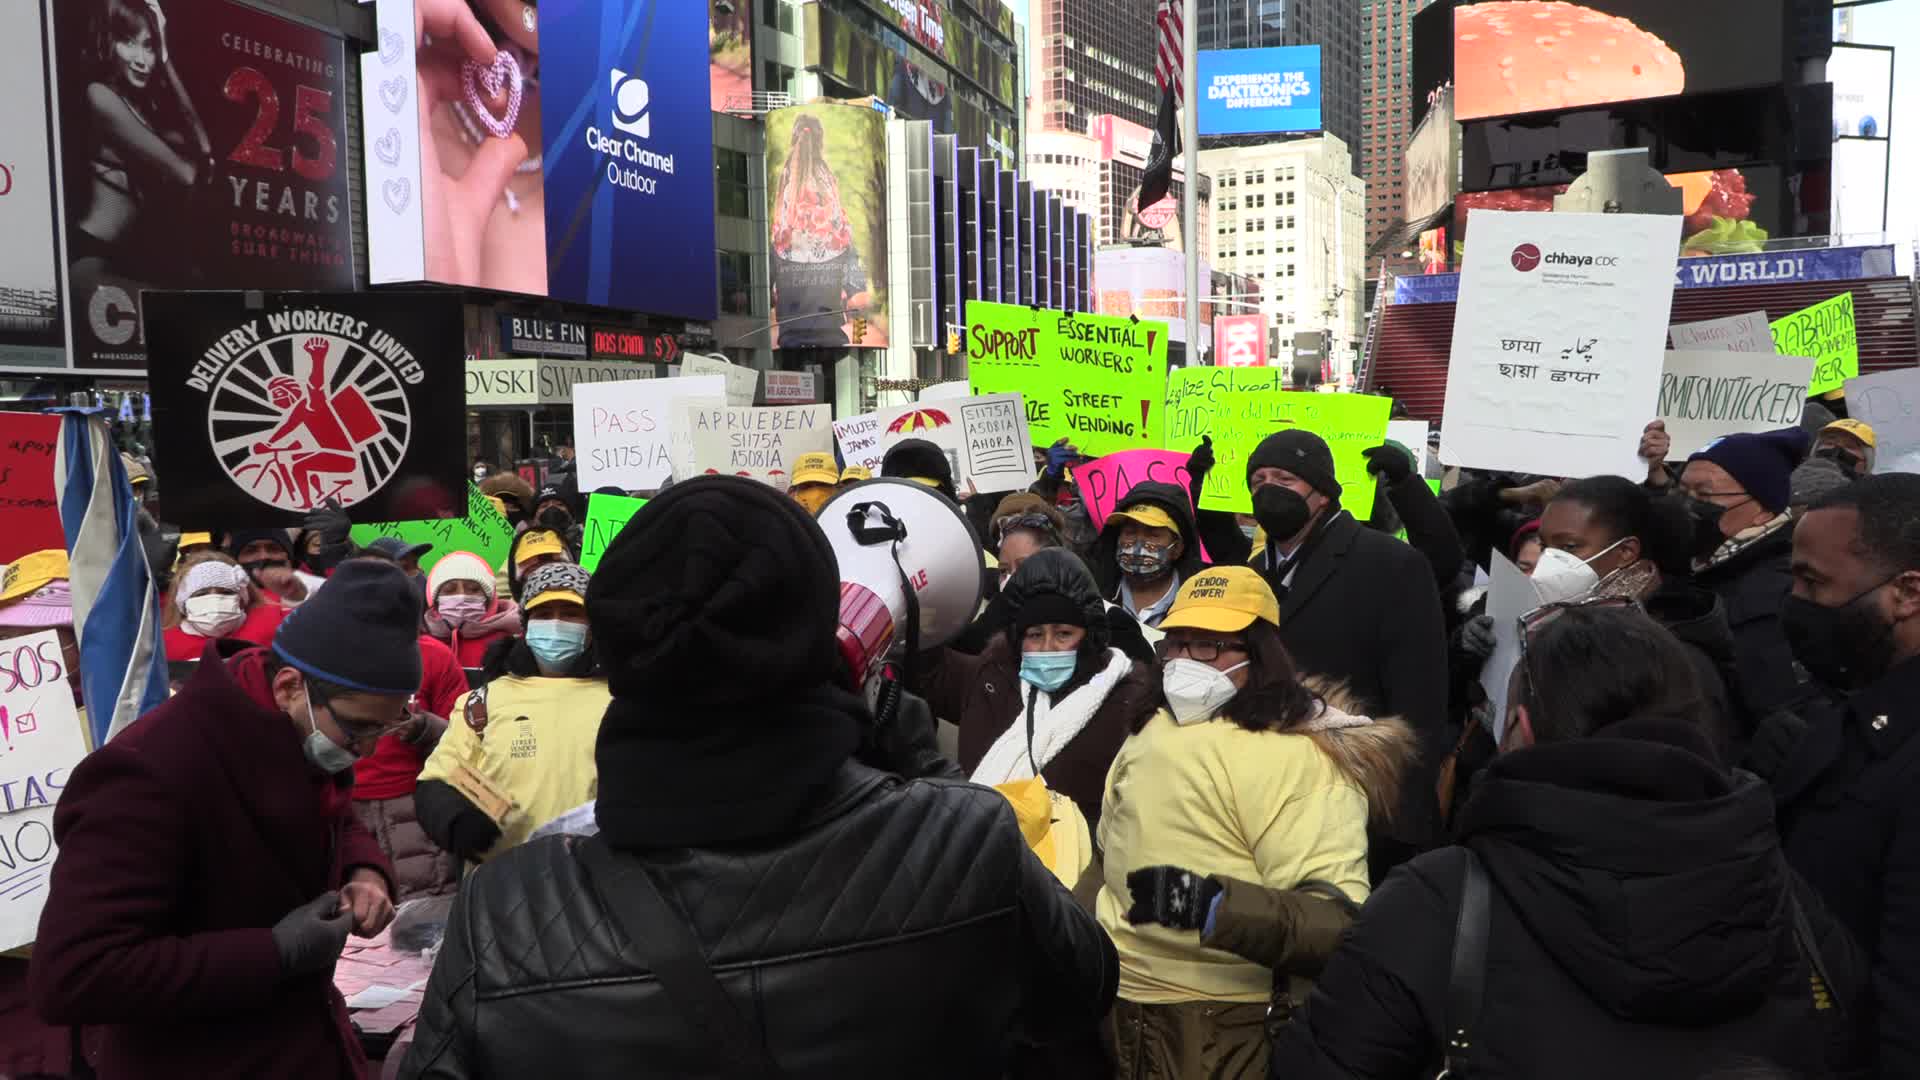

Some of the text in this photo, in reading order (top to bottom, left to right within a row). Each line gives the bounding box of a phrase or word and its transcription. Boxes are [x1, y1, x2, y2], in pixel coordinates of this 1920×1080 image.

[919, 4, 944, 44] Time
[222, 32, 336, 78] CELEBRATING
[1208, 81, 1311, 99] DAKTRONICS
[1213, 71, 1305, 86] EXPERIENCE THE
[1226, 96, 1292, 109] DIFFERENCE
[224, 66, 337, 180] 25
[586, 126, 674, 174] Clear Channel
[607, 161, 657, 195] Outdoor
[229, 175, 340, 224] YEARS
[1544, 251, 1620, 268] chhaya CDC
[1690, 258, 1804, 284] WORLD!
[512, 317, 586, 343] BLUE FIN
[970, 323, 1041, 361] SUPPORT
[1057, 317, 1145, 348] ESSENTIAL
[186, 309, 425, 393] DELIVERY WORKERS UNITED
[1059, 346, 1134, 374] WORKERS
[1063, 388, 1123, 410] STREET
[592, 407, 656, 437] PASS
[697, 409, 816, 430] APRUEBEN
[965, 407, 1012, 421] S1175A
[1065, 412, 1135, 438] VENDING
[730, 433, 783, 449] S1175A
[971, 435, 1014, 451] AHORA
[1188, 588, 1226, 600] POWER!
[1194, 576, 1229, 588] VENDOR
